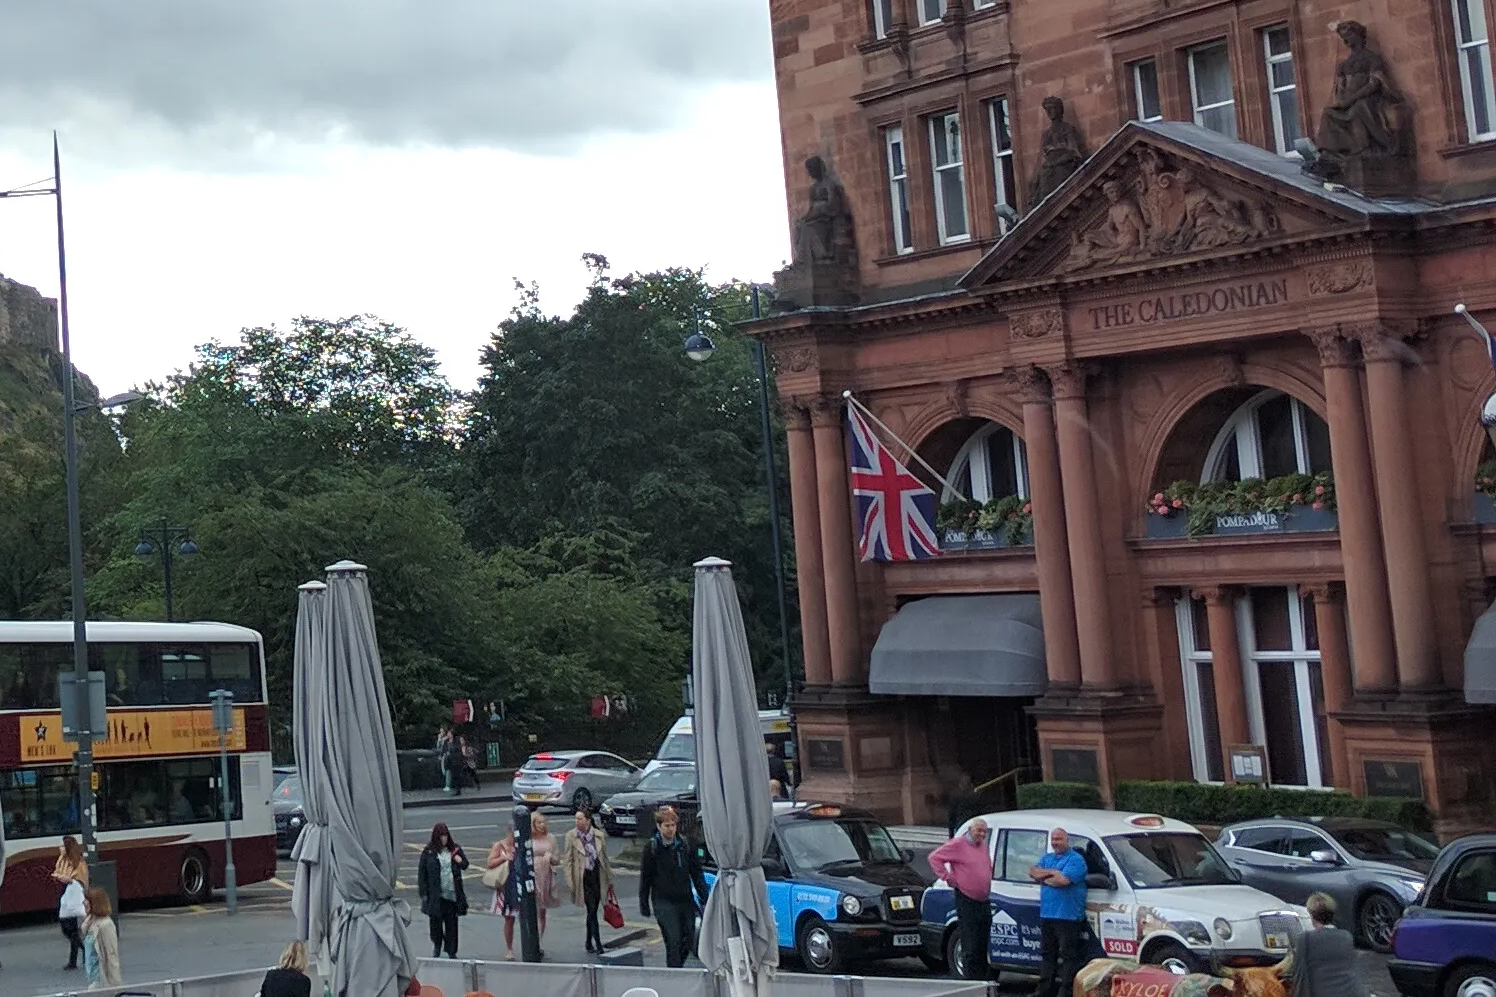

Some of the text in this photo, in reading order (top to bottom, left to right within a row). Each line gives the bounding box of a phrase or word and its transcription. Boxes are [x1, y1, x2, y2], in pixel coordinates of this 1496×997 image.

[1088, 278, 1289, 329] THE CALEDONIAN
[1216, 511, 1279, 528] POMPADOUR
[990, 924, 1018, 936] ESPC
[1109, 940, 1133, 953] SOLD
